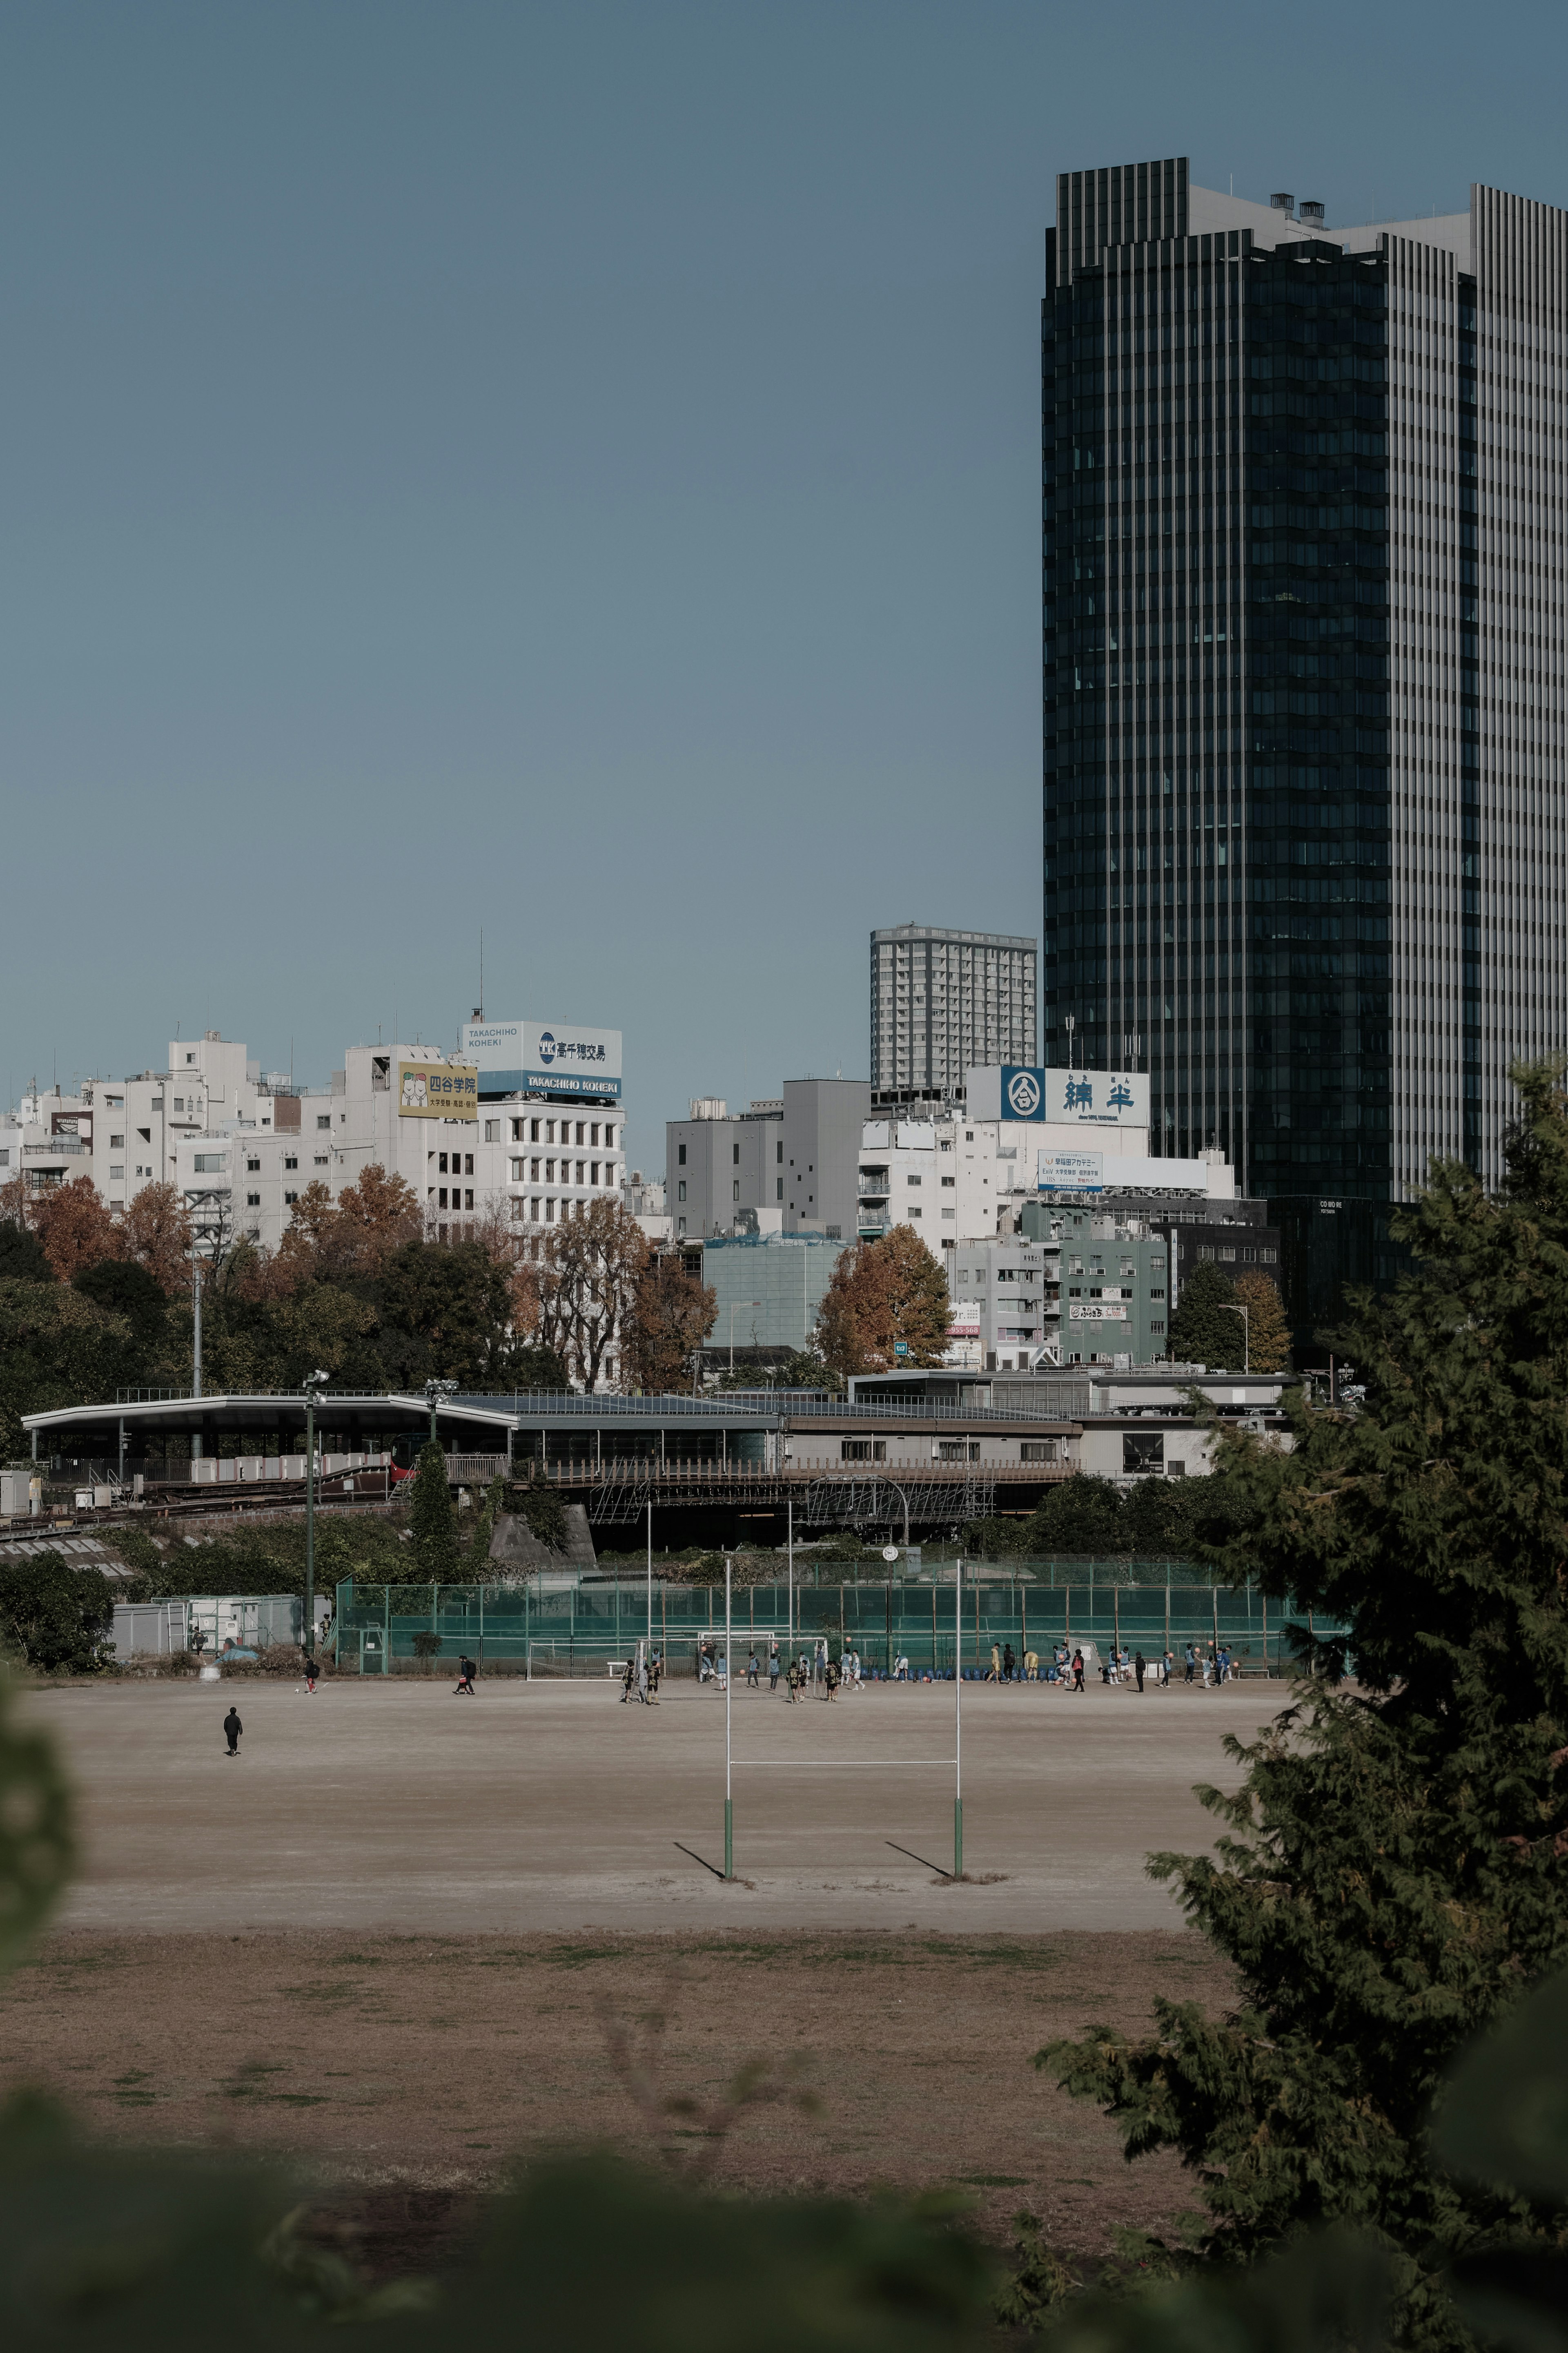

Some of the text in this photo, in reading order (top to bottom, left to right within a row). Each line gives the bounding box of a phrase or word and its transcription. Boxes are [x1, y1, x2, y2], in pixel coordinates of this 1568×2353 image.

[469, 1028, 517, 1037] TAKACHIHO
[469, 1039, 501, 1047] KOHEKI
[539, 1041, 555, 1055] TK
[556, 1042, 606, 1062] 高千穂交易
[430, 1075, 476, 1094] 四谷学院
[527, 1076, 617, 1094] TAKACHIHO KOHEKI
[1055, 1158, 1096, 1166] 早稲田アカデミー
